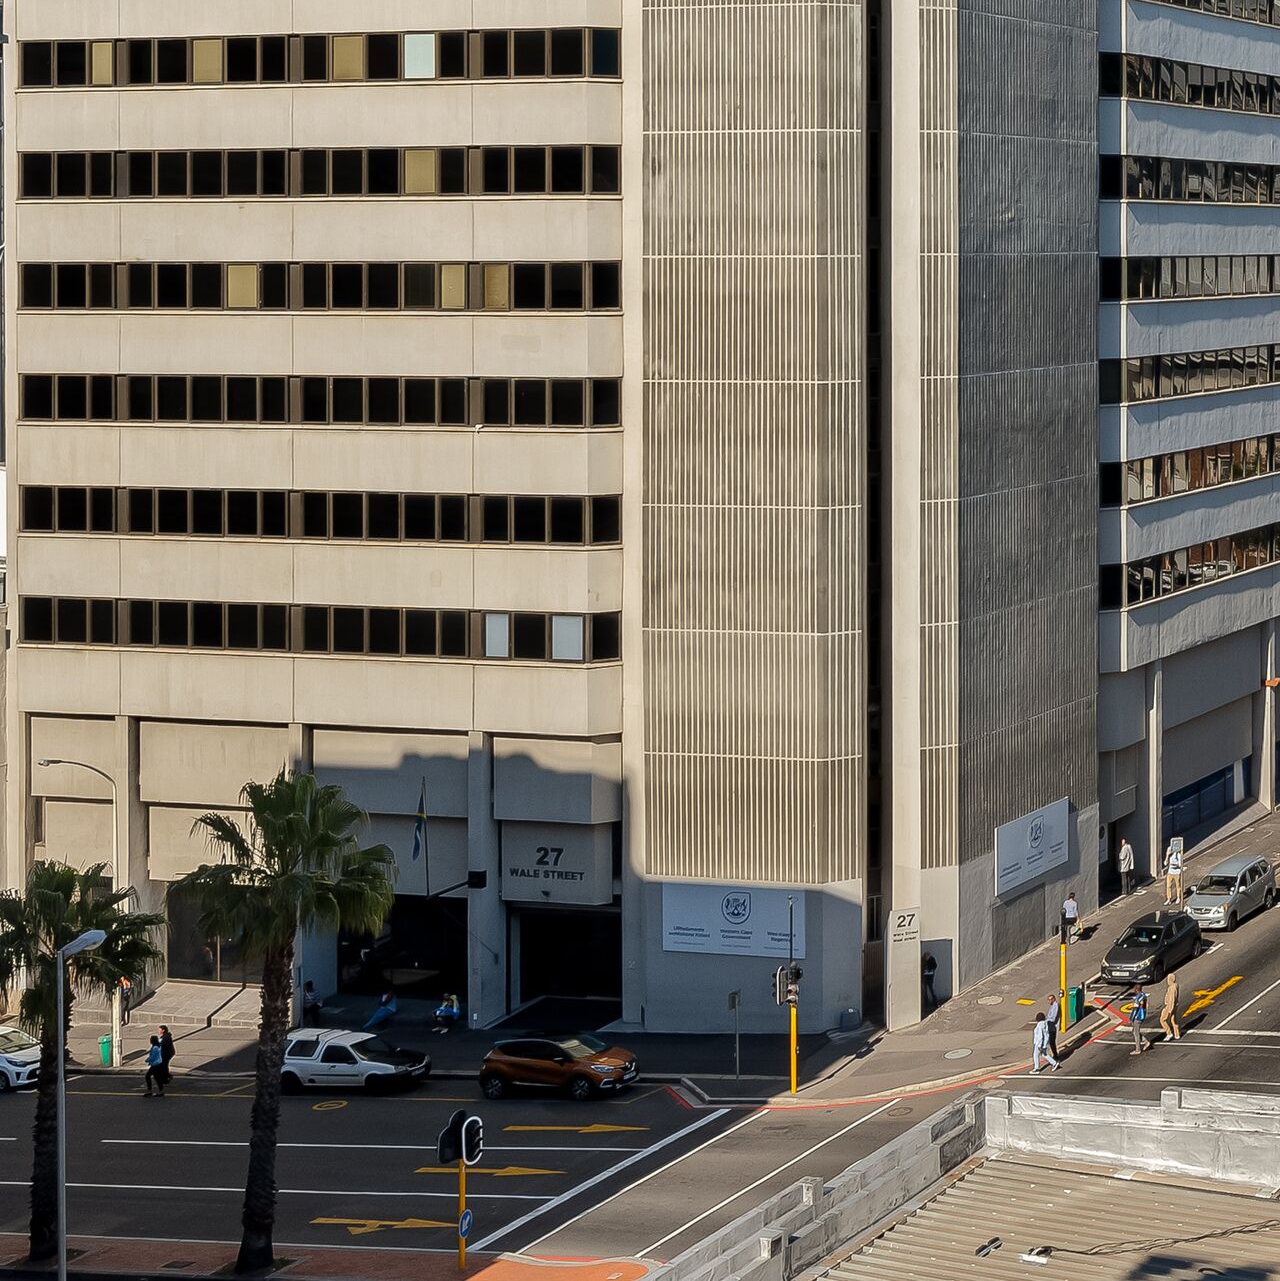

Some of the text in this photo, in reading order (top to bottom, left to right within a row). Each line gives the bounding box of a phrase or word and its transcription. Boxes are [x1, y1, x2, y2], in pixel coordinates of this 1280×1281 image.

[536, 846, 564, 866] 27
[509, 868, 585, 881] WALE STREET
[897, 914, 915, 928] 27
